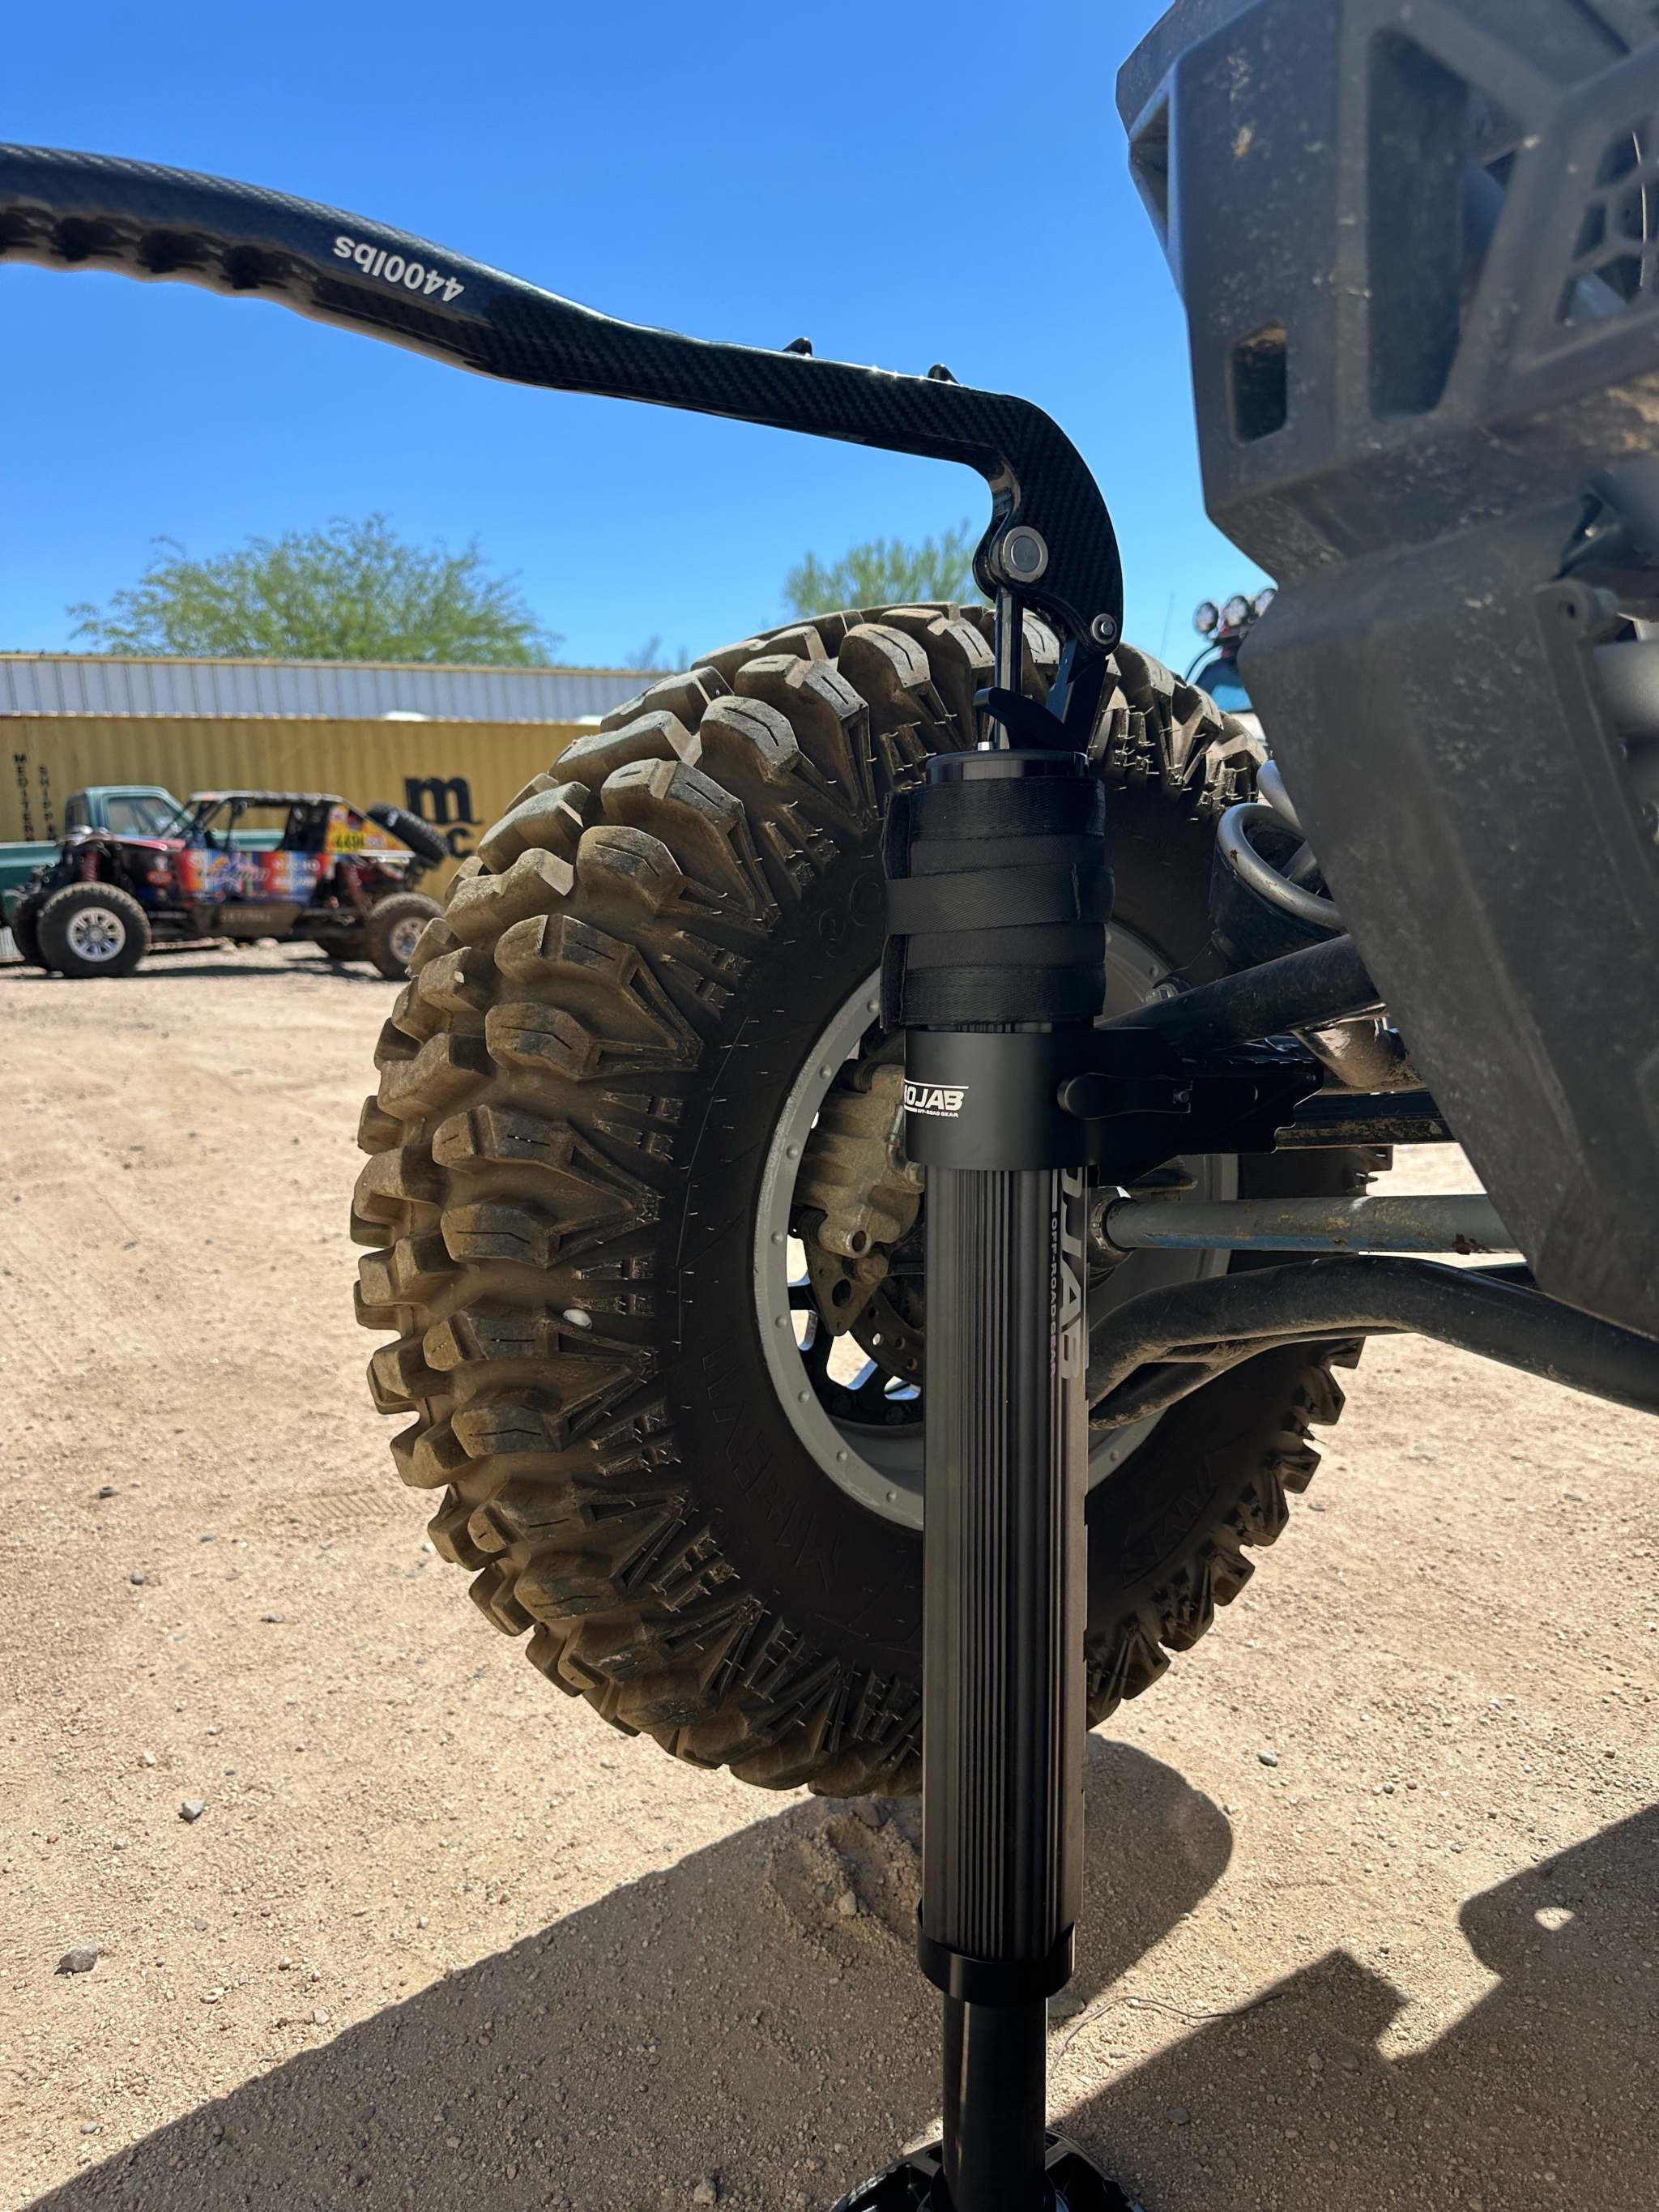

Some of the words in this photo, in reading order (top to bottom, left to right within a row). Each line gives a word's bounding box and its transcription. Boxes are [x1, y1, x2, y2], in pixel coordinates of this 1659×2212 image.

[333, 236, 466, 302] 4400lbs
[446, 827, 476, 859] c
[904, 1084, 965, 1111] OJAB
